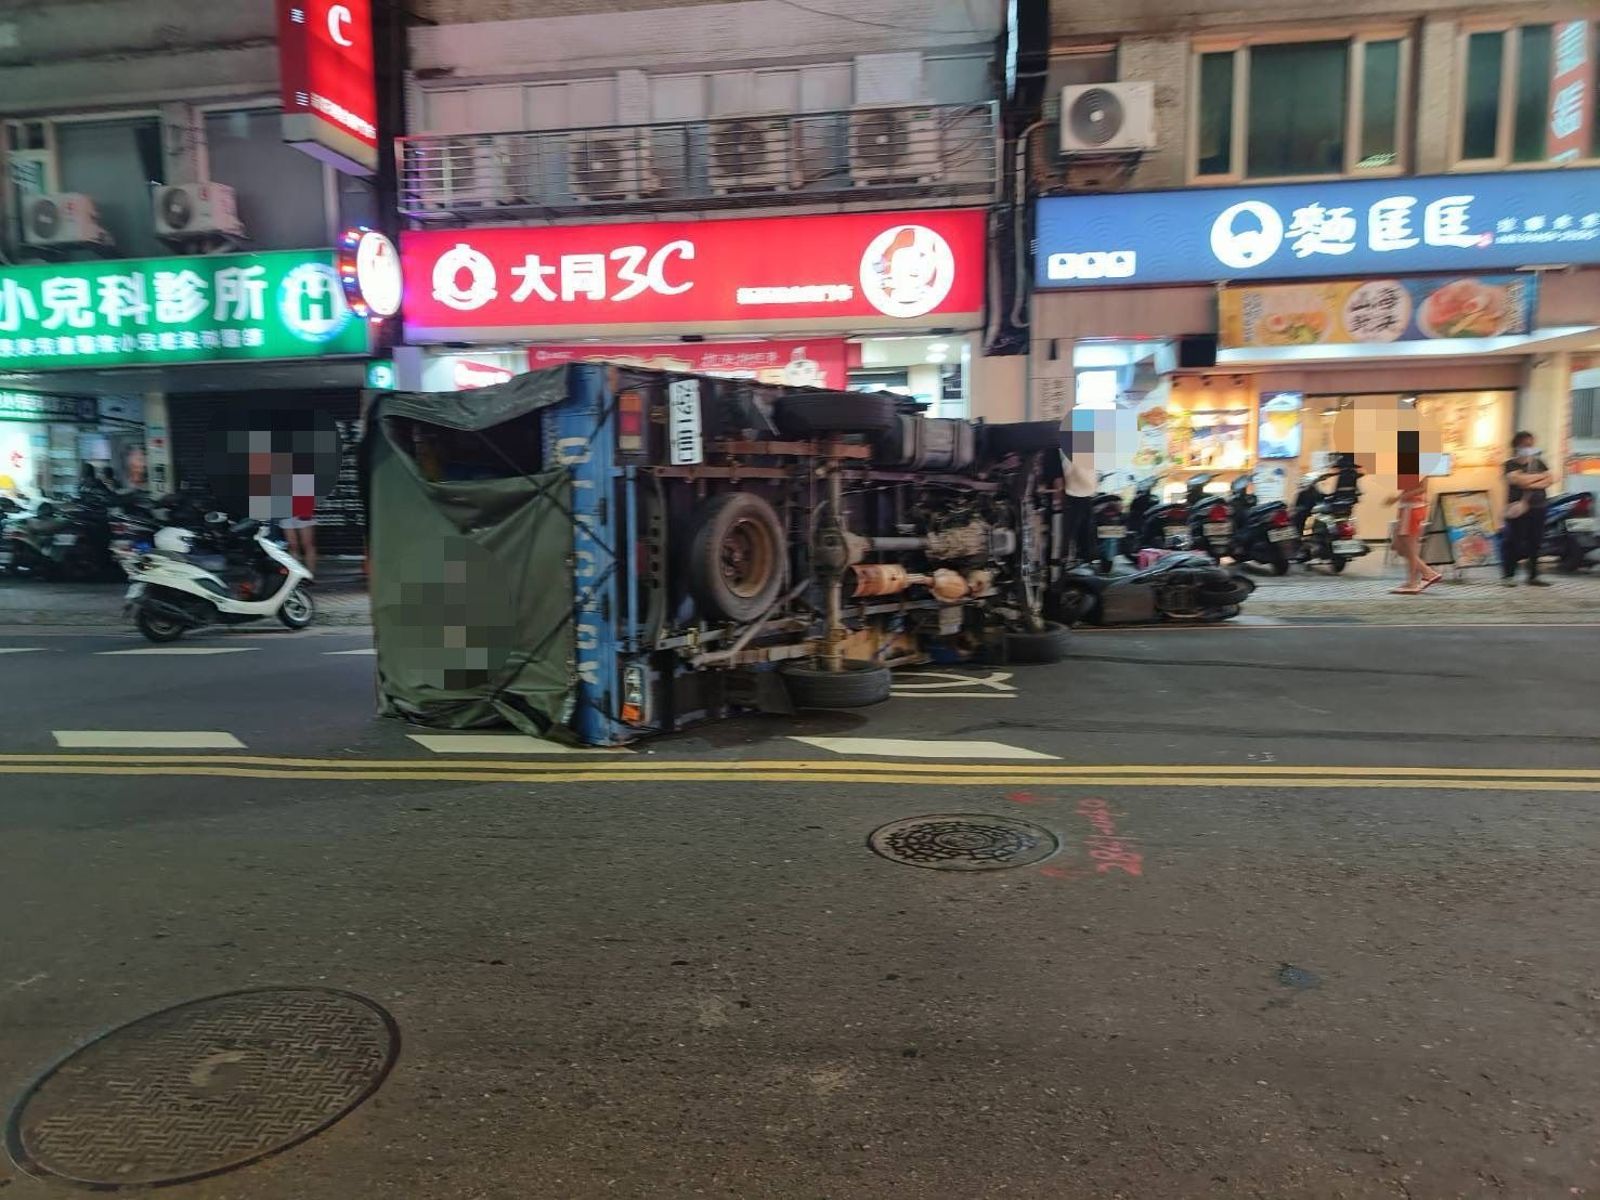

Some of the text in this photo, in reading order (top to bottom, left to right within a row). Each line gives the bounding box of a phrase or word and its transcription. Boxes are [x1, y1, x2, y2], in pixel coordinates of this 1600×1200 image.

[1285, 195, 1483, 258] 麵匡匡
[0, 265, 268, 333] 小兒科診所
[510, 240, 696, 302] 大同3C
